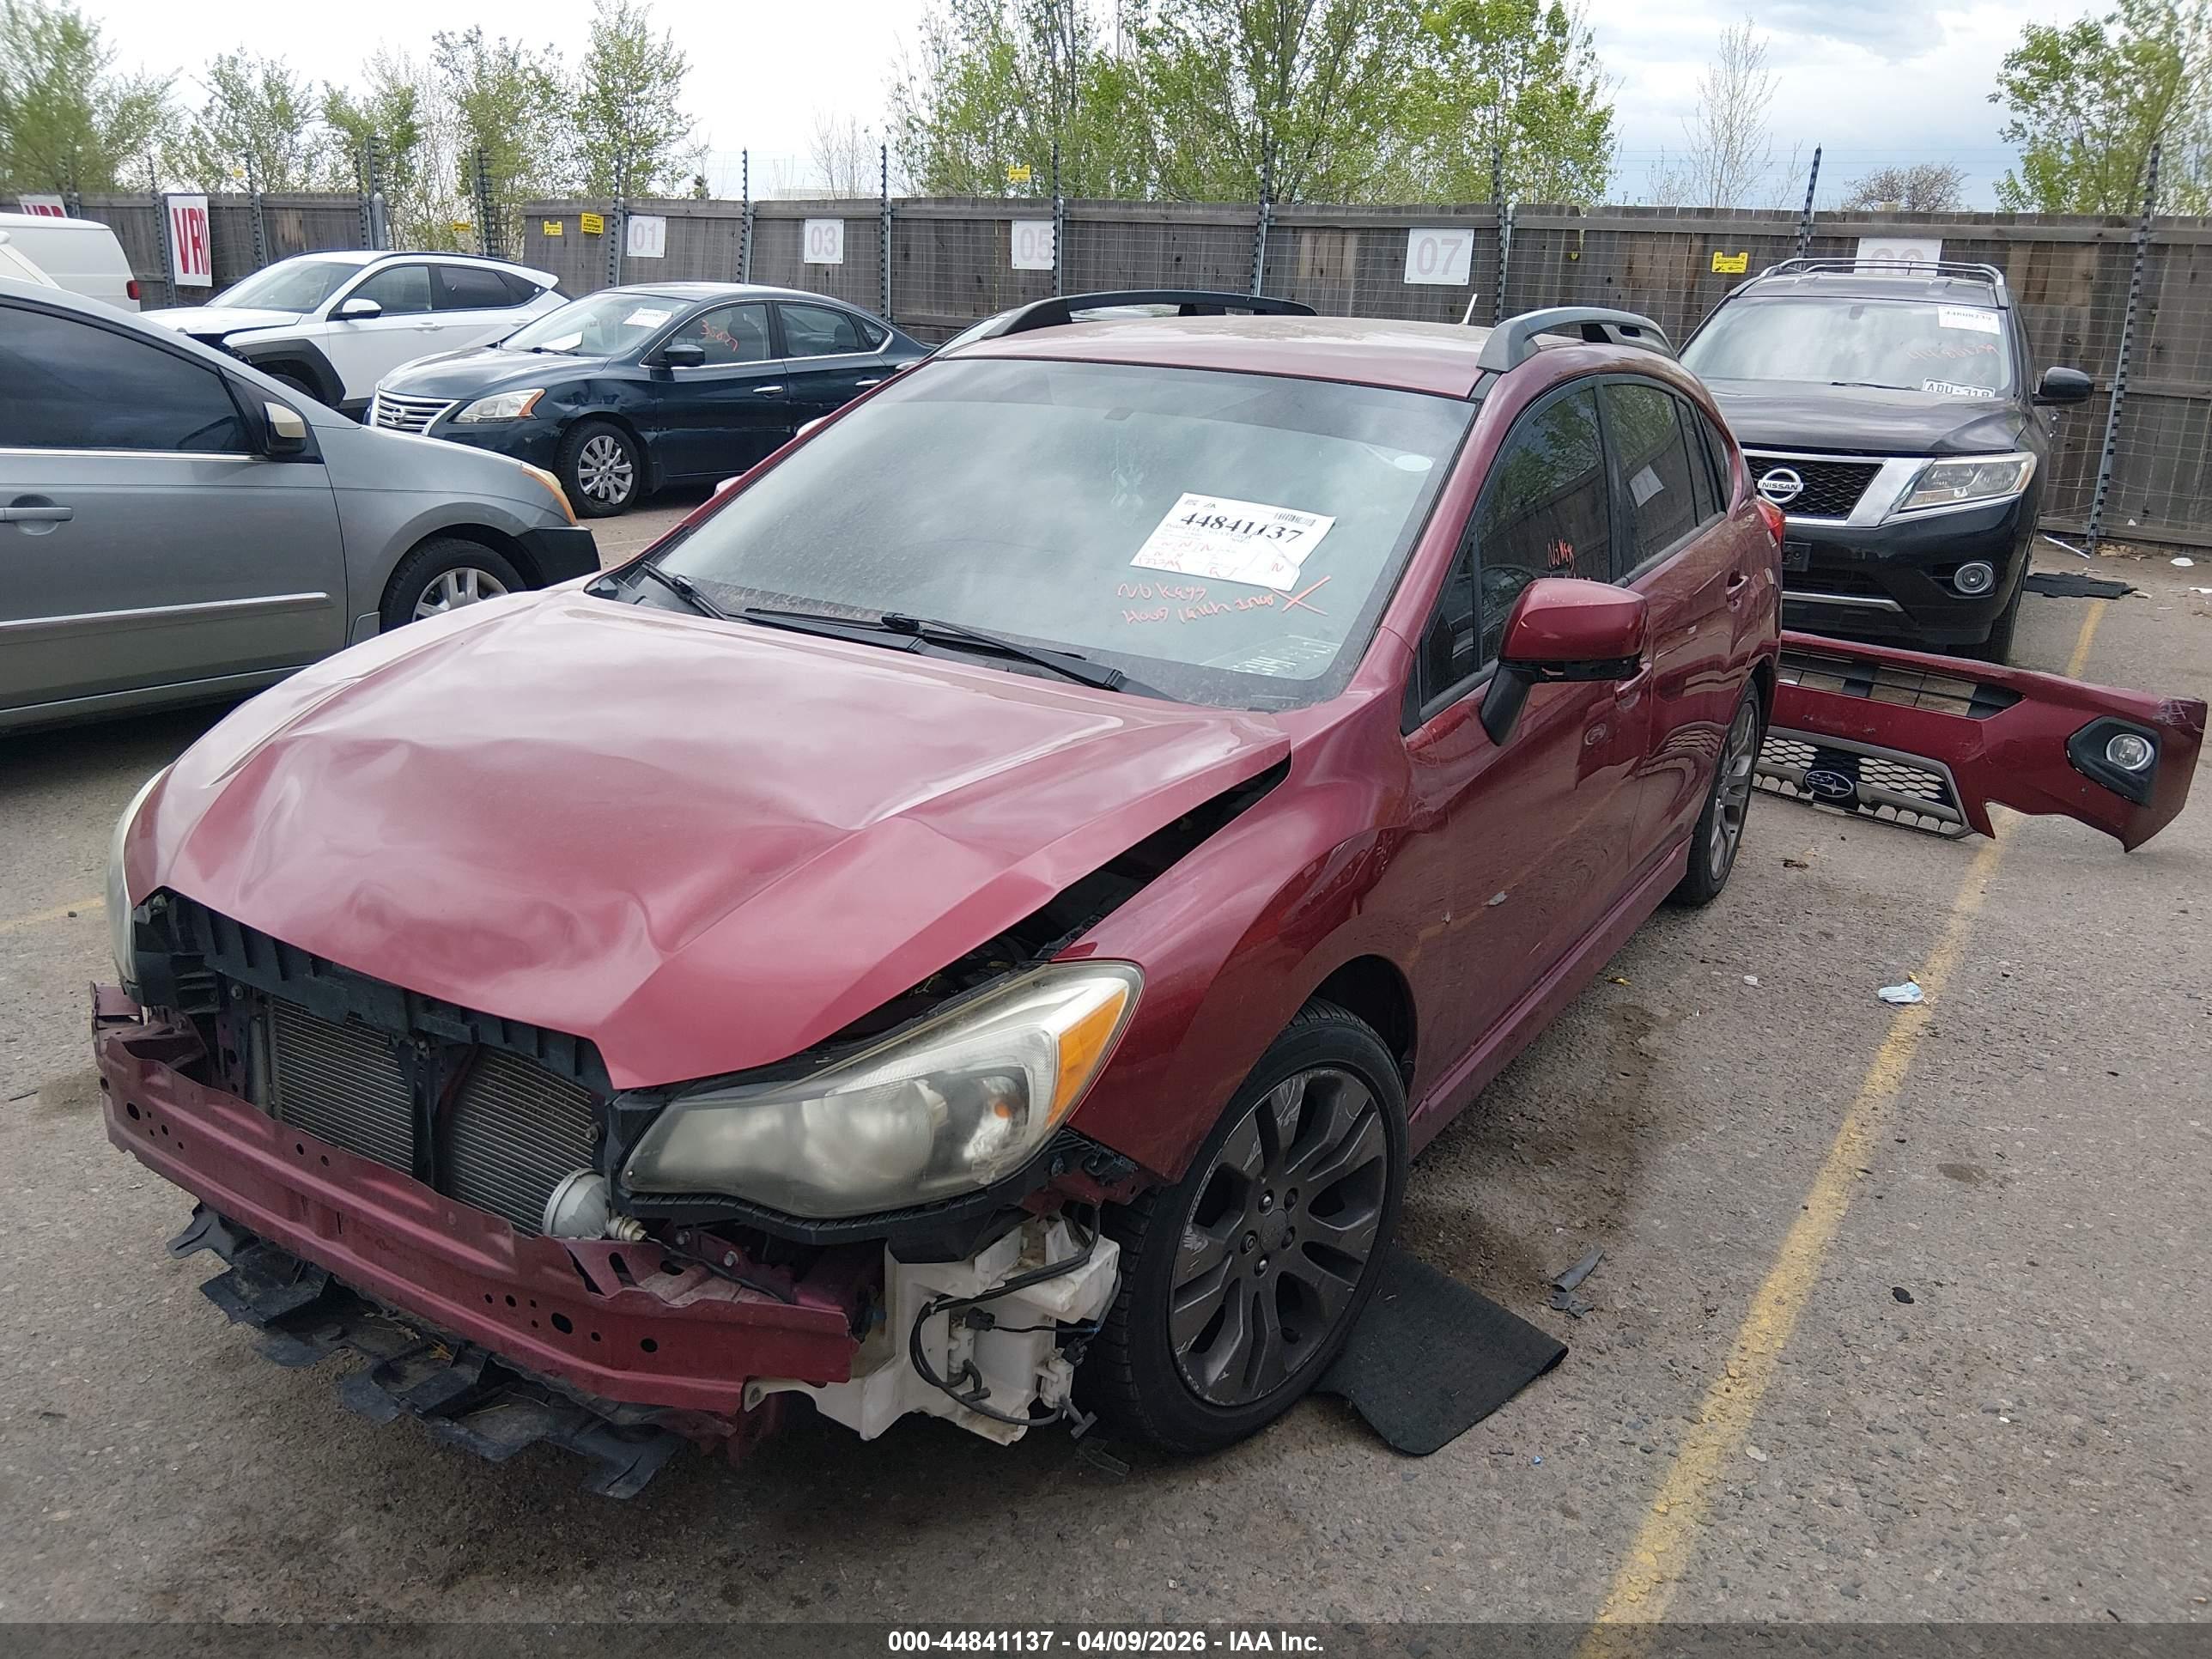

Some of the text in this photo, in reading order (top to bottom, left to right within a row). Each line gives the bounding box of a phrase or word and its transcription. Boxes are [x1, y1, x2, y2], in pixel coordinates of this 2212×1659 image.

[634, 222, 656, 250] 01
[811, 226, 836, 256] 03
[1020, 228, 1052, 261] 05
[1417, 237, 1463, 276] 07
[1761, 482, 1799, 490] NISSAN
[1181, 512, 1304, 544] 44841137
